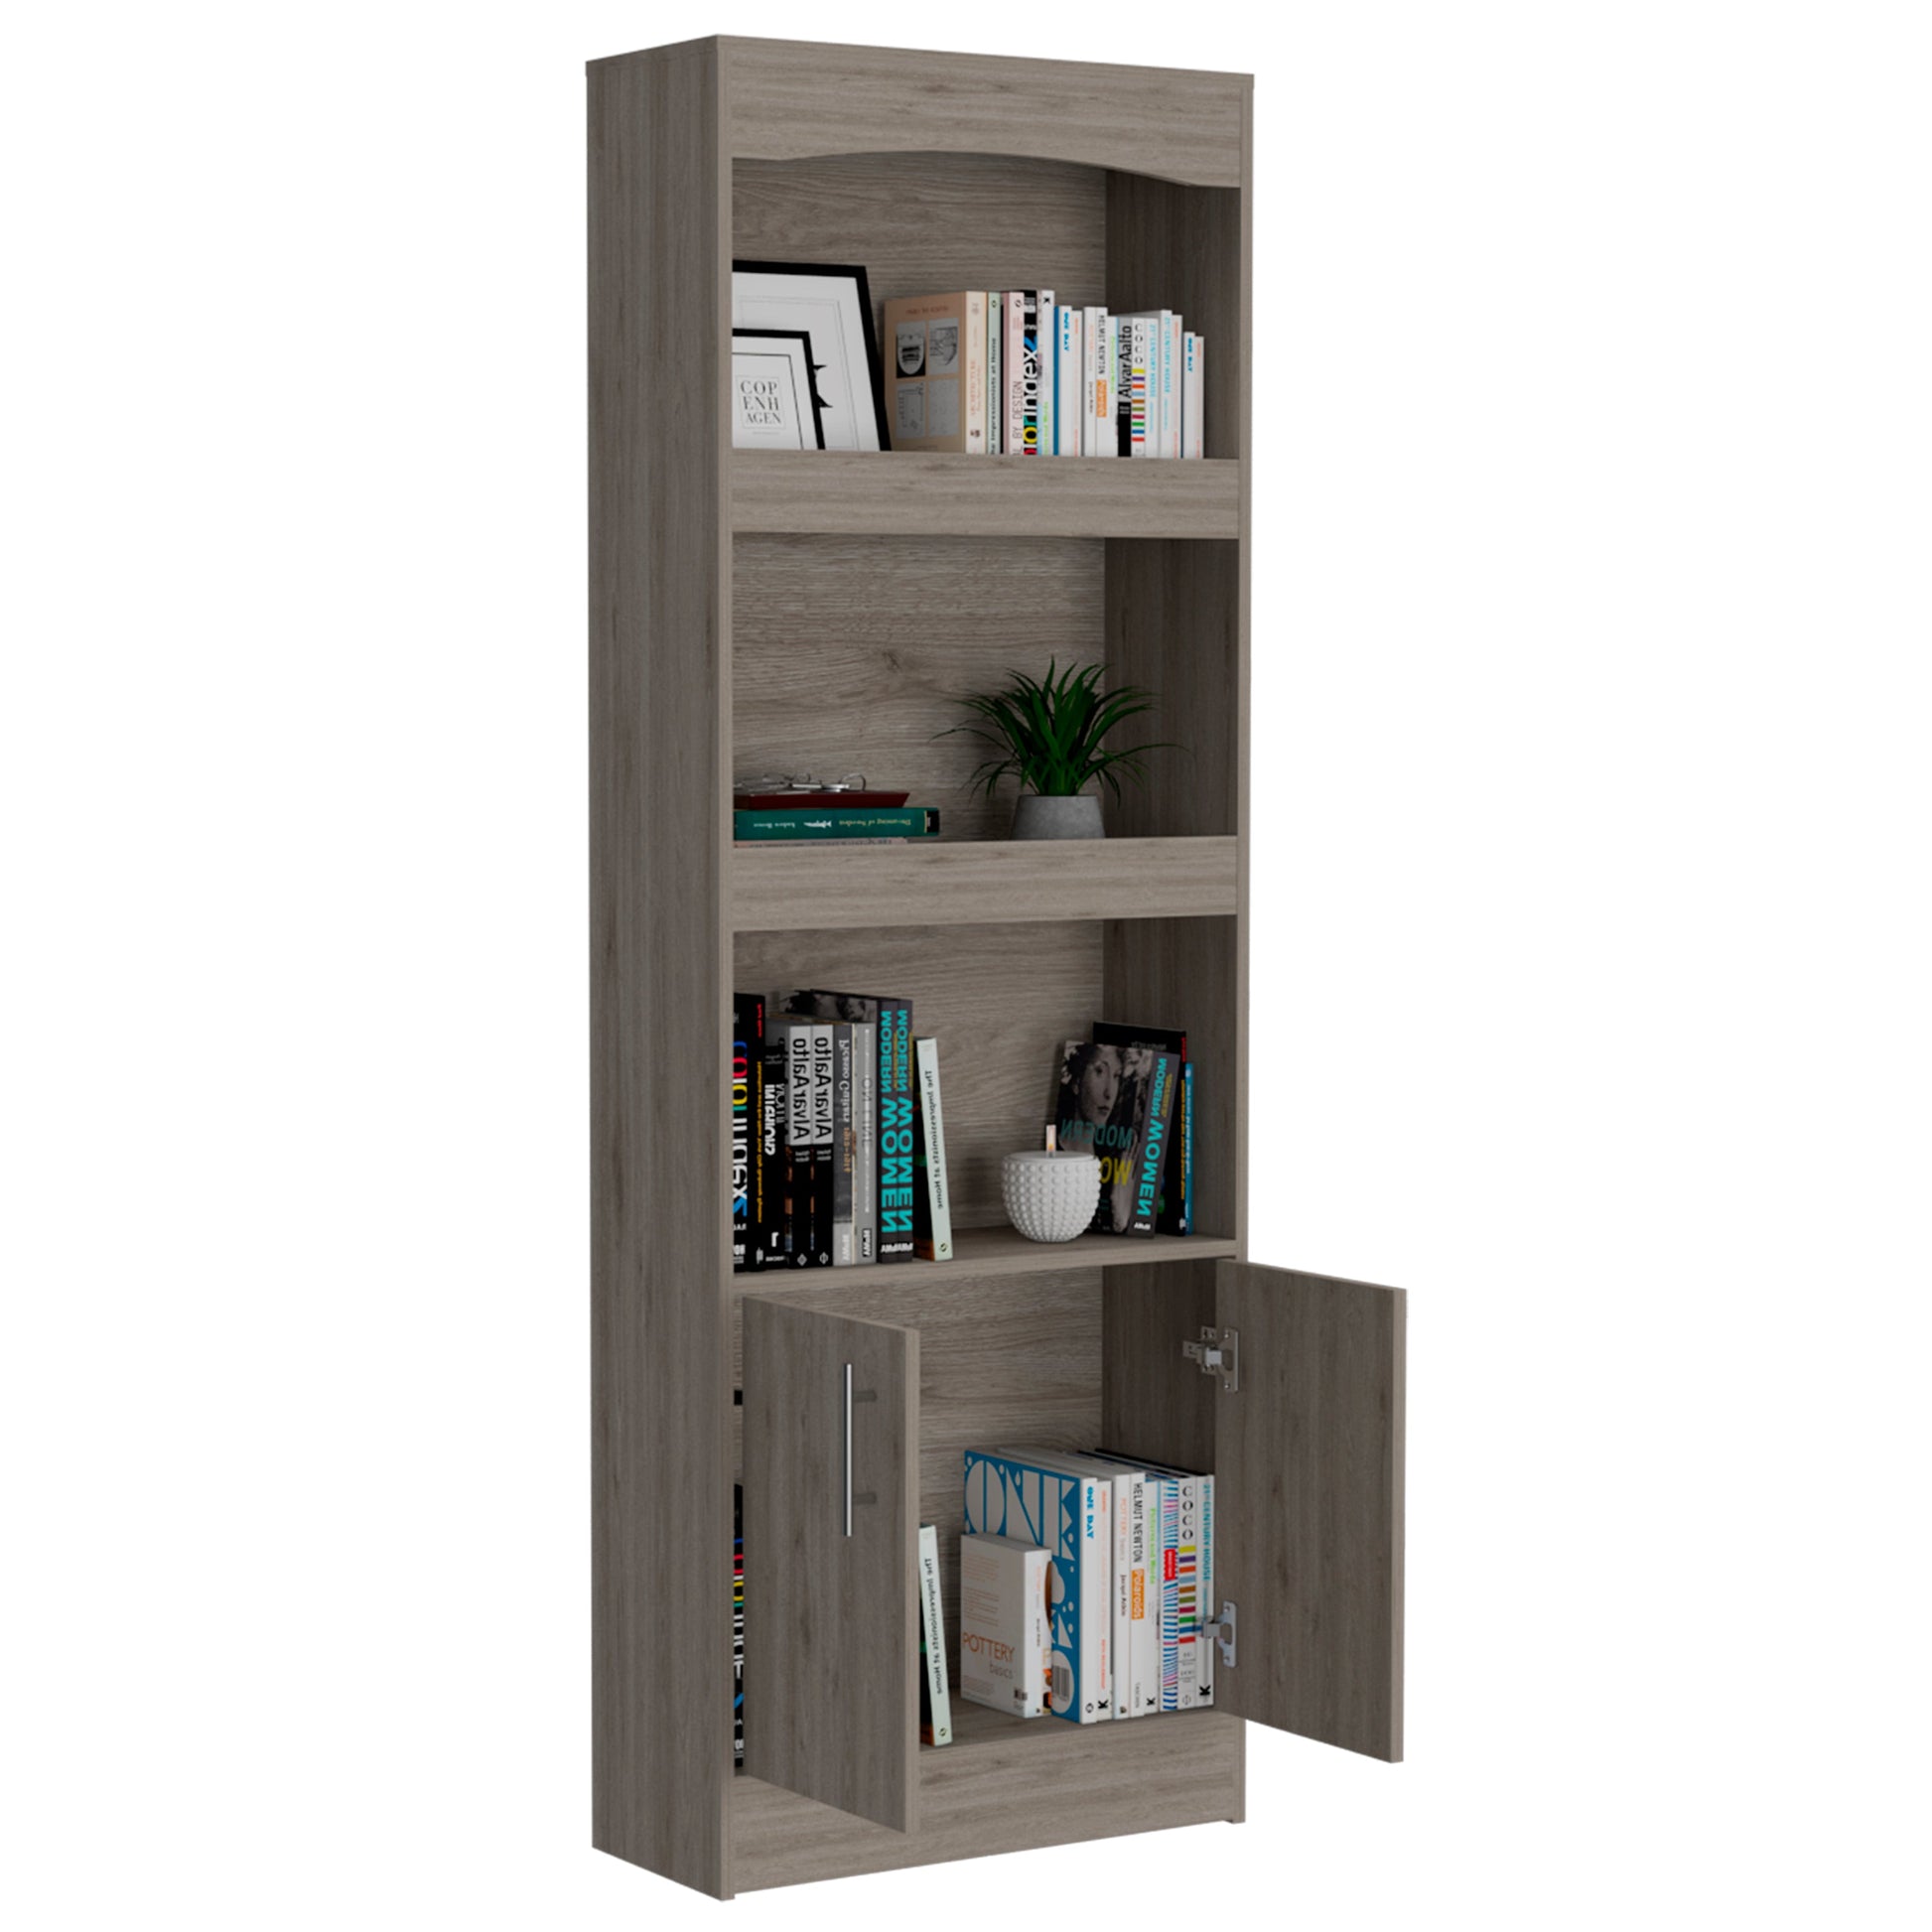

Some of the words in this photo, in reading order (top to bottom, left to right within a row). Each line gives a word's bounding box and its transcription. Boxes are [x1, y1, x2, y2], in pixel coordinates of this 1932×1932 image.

[740, 380, 777, 395] COP
[743, 396, 779, 411] ENH
[1012, 381, 1024, 420] DESIGN
[746, 412, 782, 424] AGEN
[1133, 1482, 1144, 1520] HELMUT
[1181, 1485, 1193, 1541] COCO
[1086, 1515, 1095, 1539] DAY
[1202, 1501, 1211, 1546] CENTURY
[1133, 1523, 1143, 1563] NEWTON
[1202, 1549, 1211, 1581] HOUSE
[962, 1632, 1016, 1663] POTTERY
